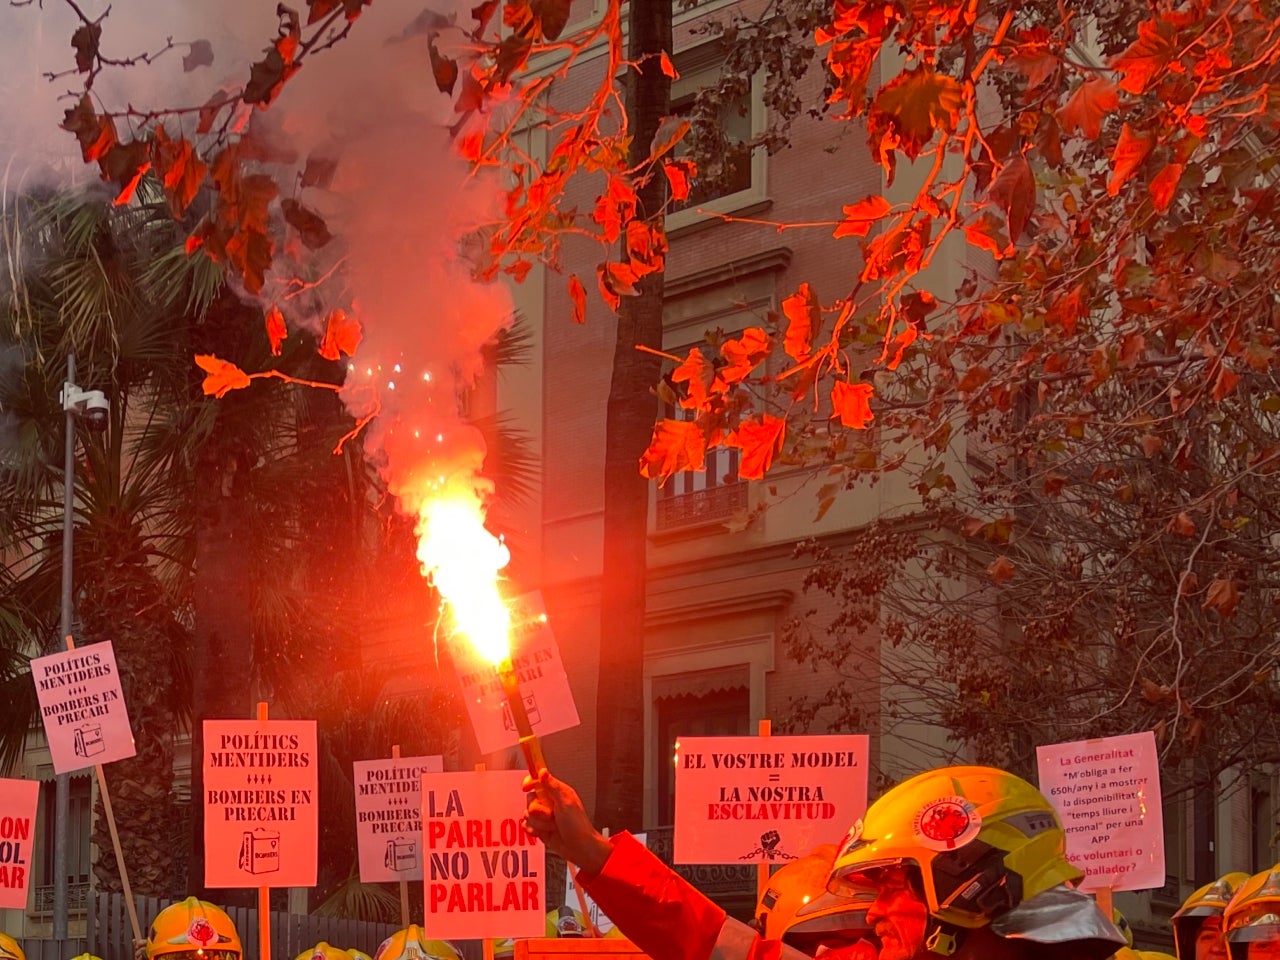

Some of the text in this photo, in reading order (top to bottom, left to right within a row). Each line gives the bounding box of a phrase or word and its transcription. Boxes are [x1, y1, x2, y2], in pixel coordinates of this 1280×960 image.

[44, 653, 101, 677] POLÍTICS
[39, 664, 111, 691] MENTIDERS
[43, 689, 118, 716] BOMBERS EN
[57, 704, 109, 725] PRECARI
[221, 731, 299, 750] POLÍTICS
[210, 753, 309, 768] MENTIDERS
[683, 752, 857, 769] EL VOSTRE MODEL
[1061, 748, 1134, 766] La Generalitat
[1119, 765, 1133, 774] fer
[719, 786, 824, 802] LA NOSTRA
[1051, 782, 1093, 796] 650h/any
[1109, 777, 1148, 788] mostrar
[208, 790, 311, 804] BOMBERS EN
[428, 790, 464, 818] LA
[1064, 793, 1136, 808] la disponibilitat
[224, 807, 296, 821] PRECARI
[359, 808, 419, 823] BOMBERS
[707, 803, 835, 820] ESCLAVITUD
[1067, 809, 1100, 820] "temps
[1102, 807, 1127, 816] lliure
[1106, 821, 1122, 831] per
[1125, 819, 1144, 827] una
[1091, 835, 1110, 844] APP
[1084, 848, 1133, 861] voluntari
[430, 850, 537, 881] NO VOL
[430, 881, 539, 913] PARLAR
